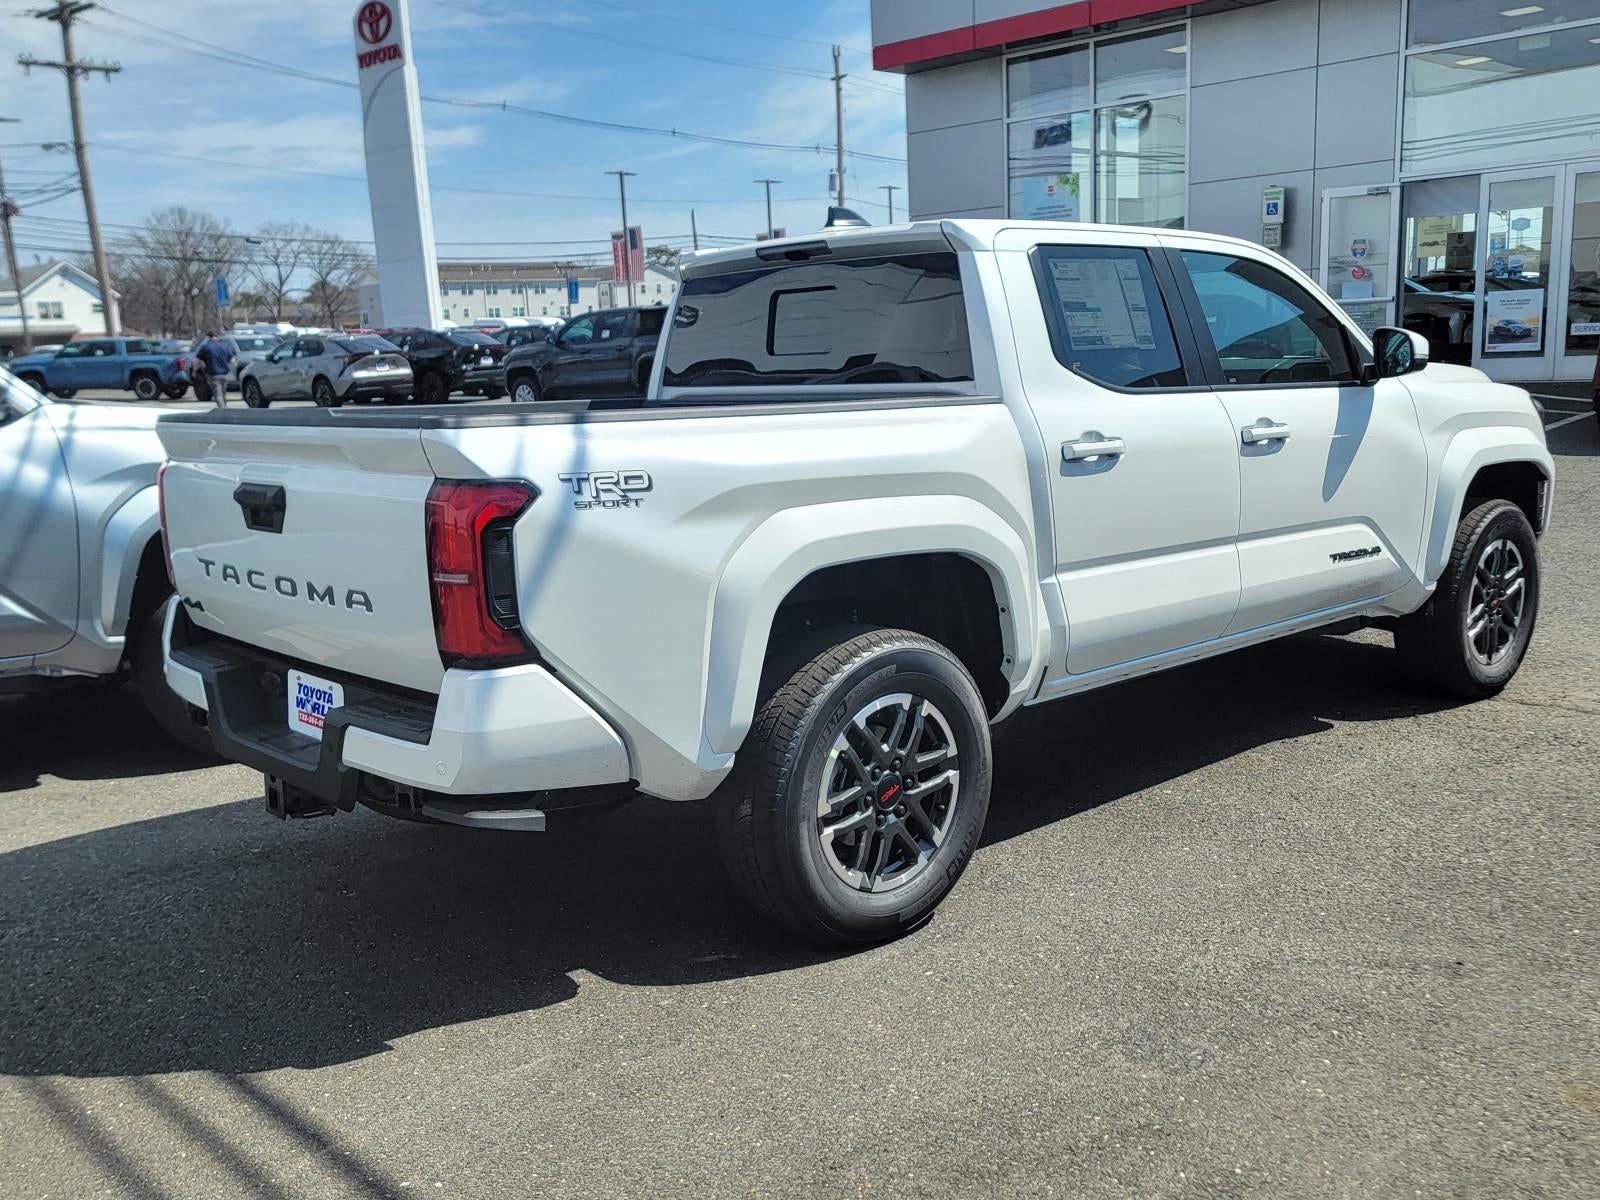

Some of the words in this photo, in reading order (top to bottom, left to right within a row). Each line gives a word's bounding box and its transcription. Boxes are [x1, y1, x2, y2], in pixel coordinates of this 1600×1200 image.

[357, 43, 402, 69] TOYOTA
[558, 469, 654, 499] TRD
[574, 498, 644, 511] SPORT
[1329, 545, 1382, 564] TACOMA
[197, 556, 374, 614] TACOMA
[297, 682, 334, 705] TOYOTA
